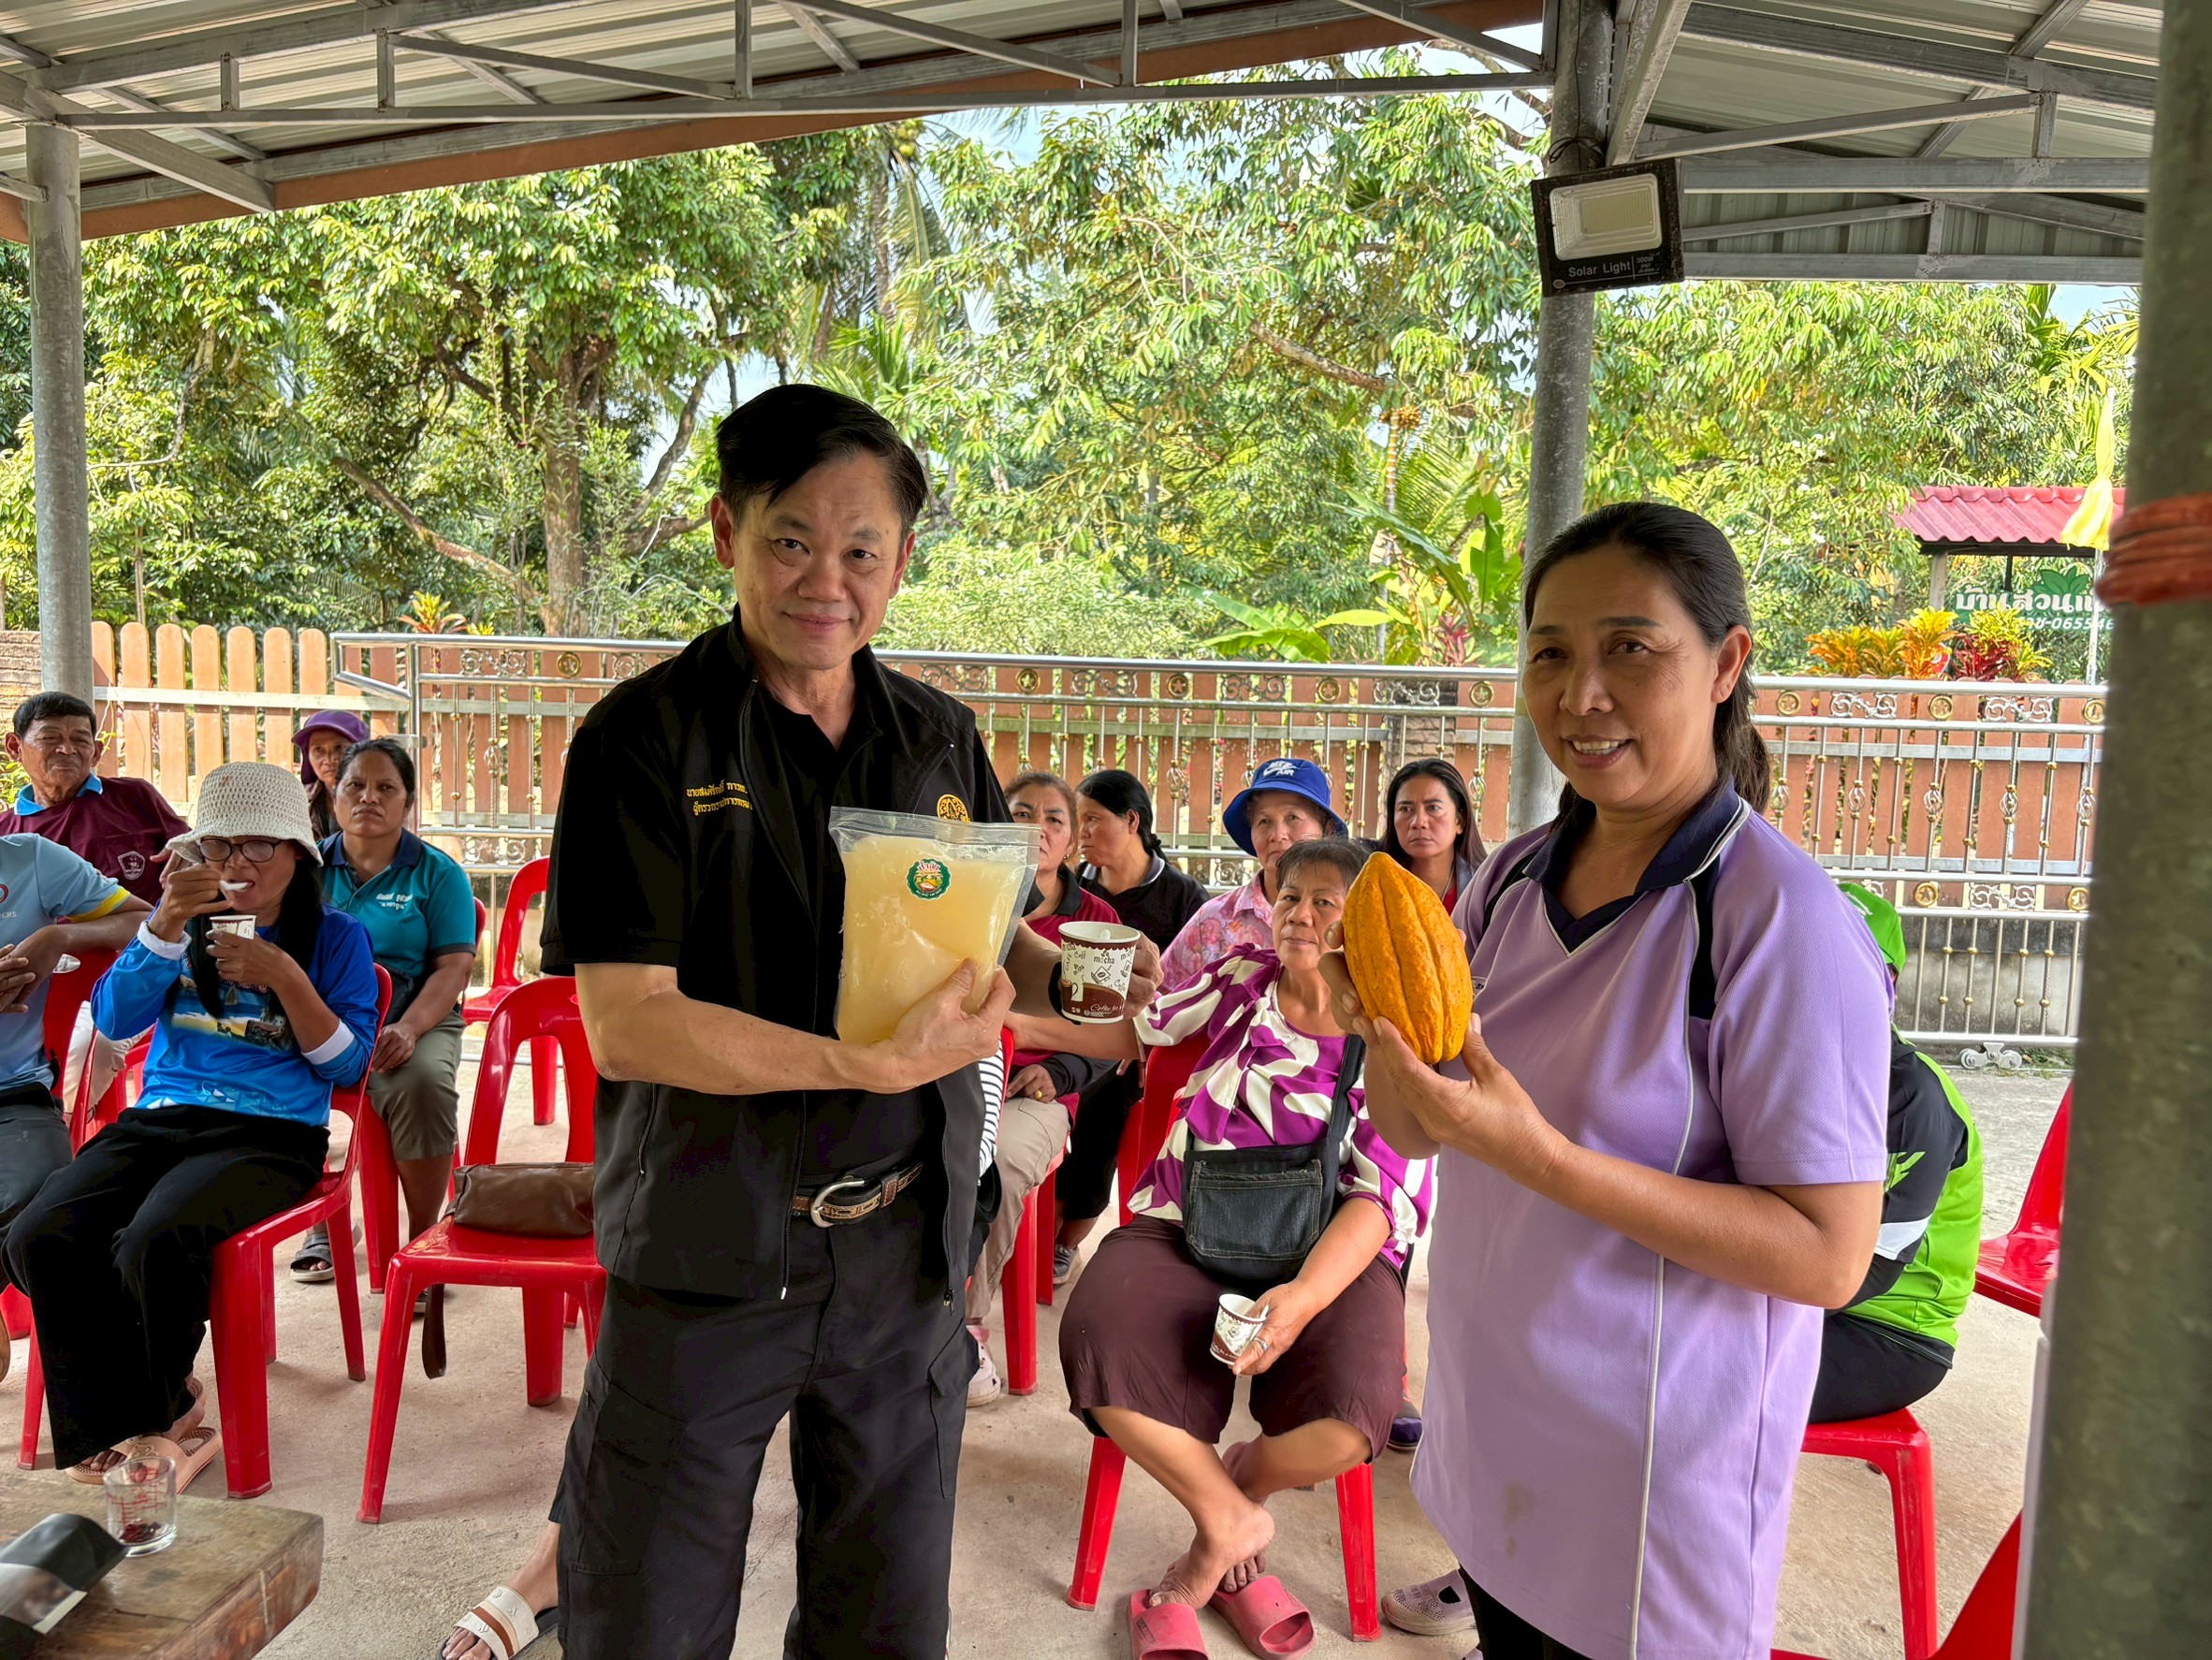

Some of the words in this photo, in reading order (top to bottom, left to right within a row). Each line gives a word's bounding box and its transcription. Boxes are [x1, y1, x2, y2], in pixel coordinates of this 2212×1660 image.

[1568, 266, 1597, 278] Solar
[1602, 260, 1631, 274] Light
[1093, 955, 1115, 965] mocha
